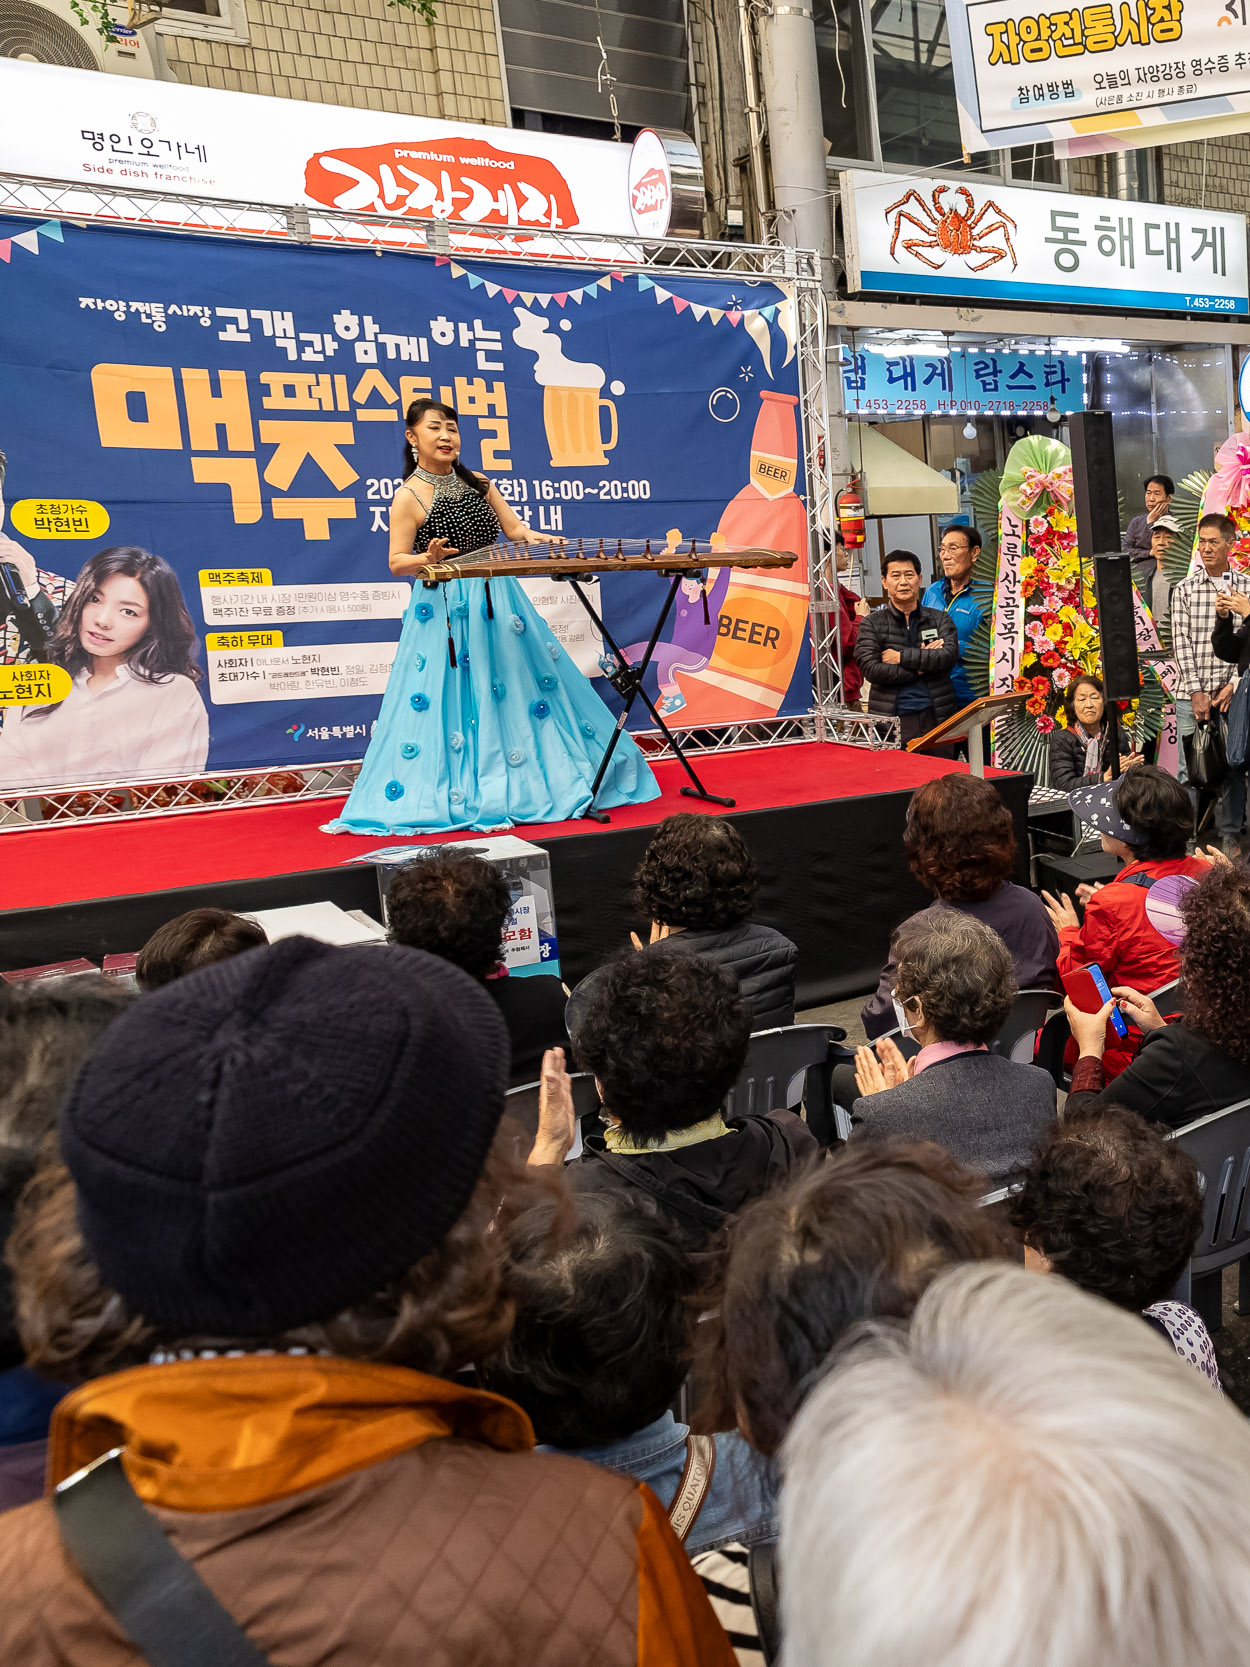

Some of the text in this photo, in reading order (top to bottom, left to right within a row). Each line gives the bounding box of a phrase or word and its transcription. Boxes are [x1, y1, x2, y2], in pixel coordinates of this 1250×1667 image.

[985, 0, 1184, 66] 자양전통시장
[1093, 69, 1131, 92] 오늘의
[1135, 61, 1187, 84] 자양강장
[1191, 54, 1230, 77] 영수증
[1017, 79, 1076, 105] 참여방법
[1157, 86, 1175, 99] 행사
[81, 130, 208, 163] 명인오가네
[394, 149, 515, 171] premium wellfood
[82, 163, 216, 185] Side dish franchise
[1044, 208, 1227, 277] 동해대게
[1185, 296, 1236, 310] T.453-2258
[215, 306, 339, 362] 고객과
[332, 308, 430, 364] 함께
[429, 315, 504, 372] 하는
[885, 355, 954, 393] 대게
[972, 356, 1071, 394] 랍스타
[852, 398, 927, 410] T.453-2258
[259, 368, 513, 471] 페스티벌
[90, 362, 361, 541] 맥주
[758, 462, 789, 482] BEER
[533, 479, 651, 501] 16:00~20:00
[36, 503, 88, 516] 초청가수
[34, 517, 91, 533] 박현빈
[208, 571, 264, 585] 맥주축제
[211, 593, 255, 606] 행사기간
[270, 593, 291, 604] 시장
[339, 590, 370, 602] 영수증
[560, 594, 594, 605] 사진기
[212, 605, 296, 618] 맥주1잔 무료 증정
[716, 613, 781, 650] BEER
[216, 634, 273, 648] 축하 무대
[217, 657, 249, 669] 사회자
[291, 654, 321, 666] 노현지
[12, 670, 51, 682] 사회자
[218, 671, 261, 683] 초대가수
[306, 723, 367, 740] 서울특별시
